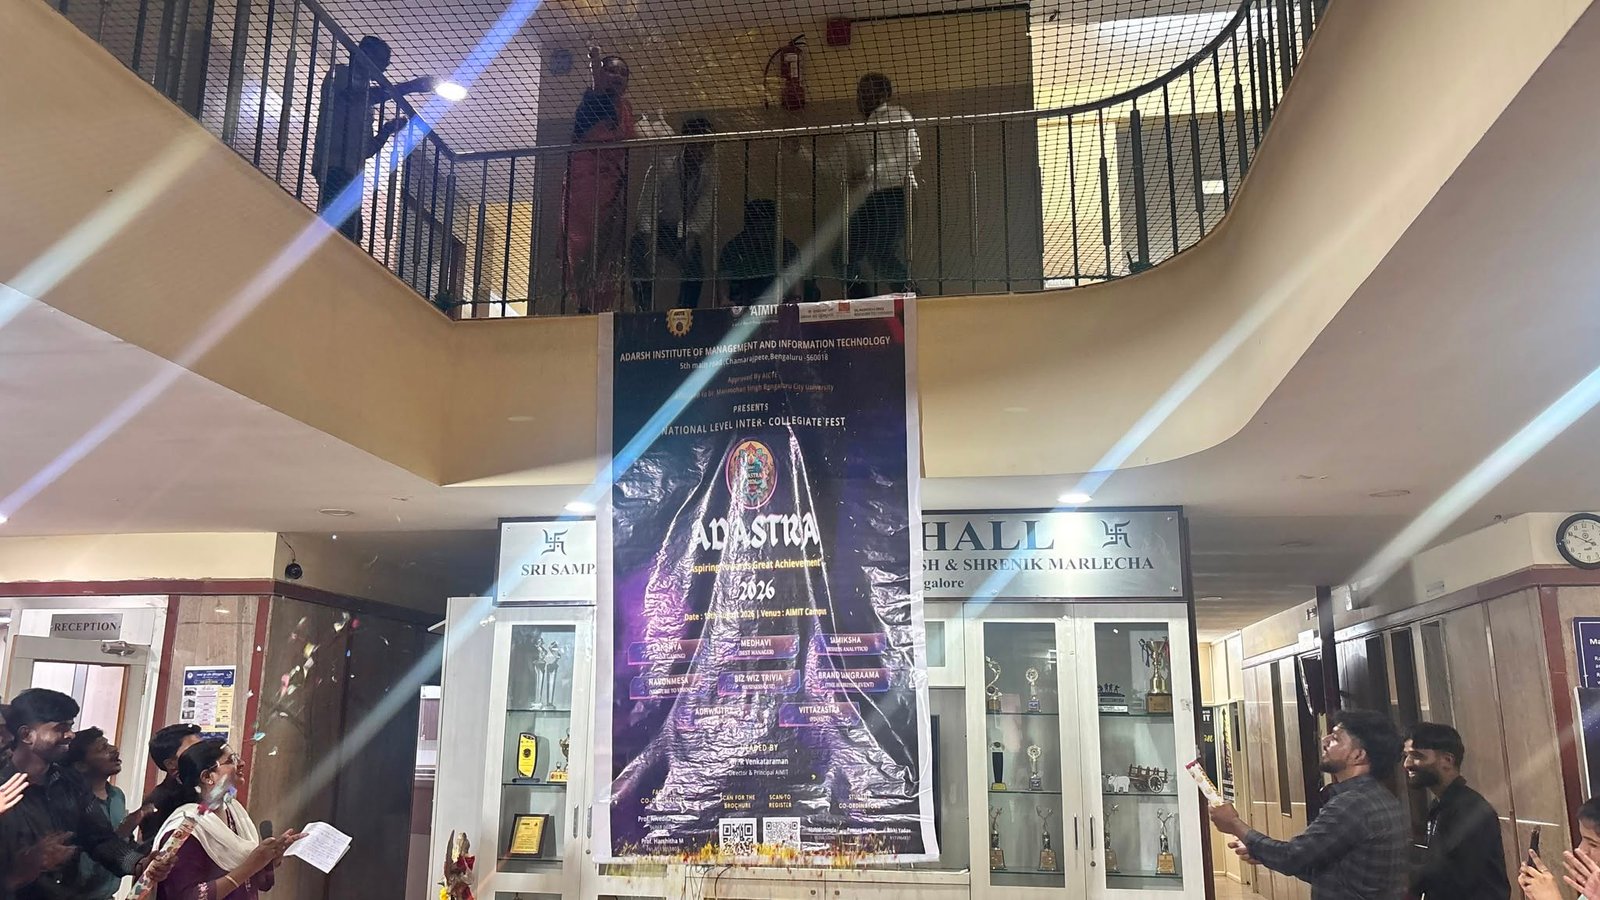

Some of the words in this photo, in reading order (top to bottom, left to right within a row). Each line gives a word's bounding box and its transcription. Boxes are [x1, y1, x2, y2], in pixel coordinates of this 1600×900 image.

[750, 304, 779, 316] AIMIT
[620, 351, 651, 362] ADARSH
[652, 348, 691, 359] INSTITUTE
[693, 347, 703, 356] OF
[705, 341, 757, 356] MANAGEMENT
[760, 340, 777, 349] AND
[778, 339, 835, 349] INFORMATION
[836, 336, 891, 347] TECHNOLOGY
[793, 383, 804, 391] City
[733, 402, 769, 413] PRESENTS
[661, 424, 707, 436] NATIONAL
[709, 421, 733, 432] LEVEL
[735, 418, 766, 429] INTER-
[768, 416, 825, 427] COLLEGIATE
[825, 416, 846, 427] FEST
[691, 512, 820, 551] ADASTRA
[922, 520, 1054, 551] HALL
[753, 560, 774, 570] Great
[945, 558, 958, 571] &
[963, 558, 1043, 571] SHRENIK
[1048, 556, 1155, 571] MARLECHA
[521, 563, 546, 576] SRI
[551, 563, 597, 576] SAMP
[740, 577, 776, 601] 2026
[684, 613, 700, 621] Date
[761, 608, 781, 618] Venue
[54, 621, 118, 632] RECEPTION
[740, 639, 772, 647] MEDHAVI
[734, 674, 745, 682] BIZ
[761, 674, 783, 682] TRIVIA
[768, 743, 779, 752] BY
[746, 757, 789, 766] Venkataraman
[753, 769, 774, 777] Principal
